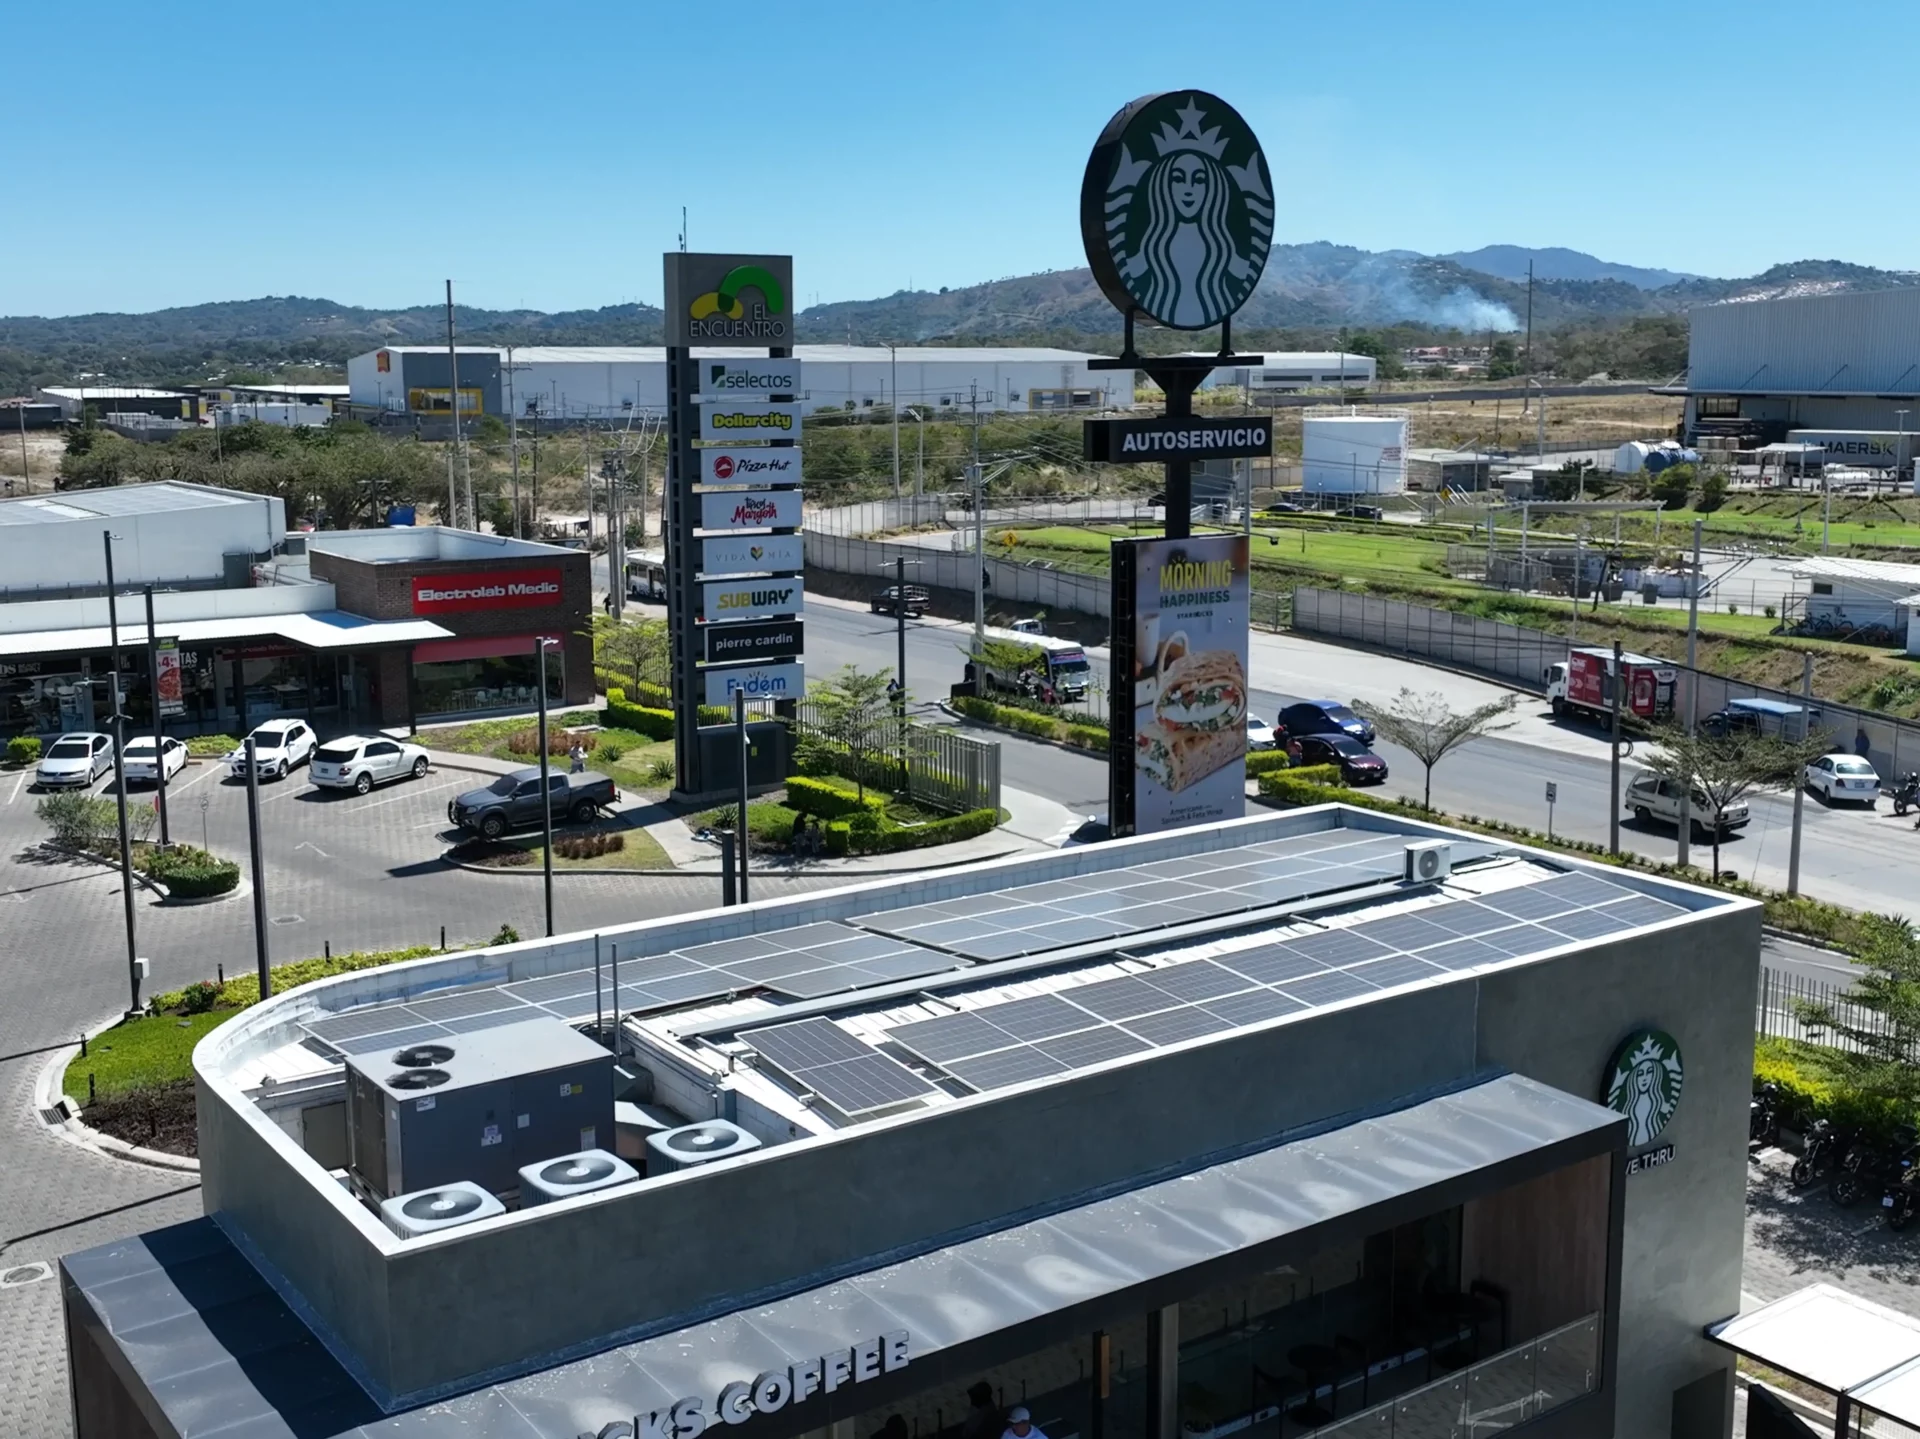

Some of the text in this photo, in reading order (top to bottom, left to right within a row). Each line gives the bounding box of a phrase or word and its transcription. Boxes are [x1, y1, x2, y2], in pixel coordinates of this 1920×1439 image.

[753, 304, 770, 320] EL
[690, 321, 786, 338] ENCUENTRO
[726, 370, 792, 389] selectos
[712, 411, 792, 431] Dollarcity
[1122, 428, 1266, 451] AUTOSERVICIO
[1820, 441, 1894, 455] MAERSK
[736, 459, 792, 473] Pizza Hut
[730, 502, 777, 525] Margoth
[716, 554, 746, 562] VIDA
[1160, 560, 1232, 592] MORNING
[418, 582, 558, 602] Electrolab Medic
[717, 588, 794, 609] SUBWAY
[1160, 590, 1230, 608] HAPPINESS
[716, 634, 793, 651] pierre cardin
[1642, 1145, 1676, 1169] THRU
[718, 1329, 910, 1425] COFFEE
